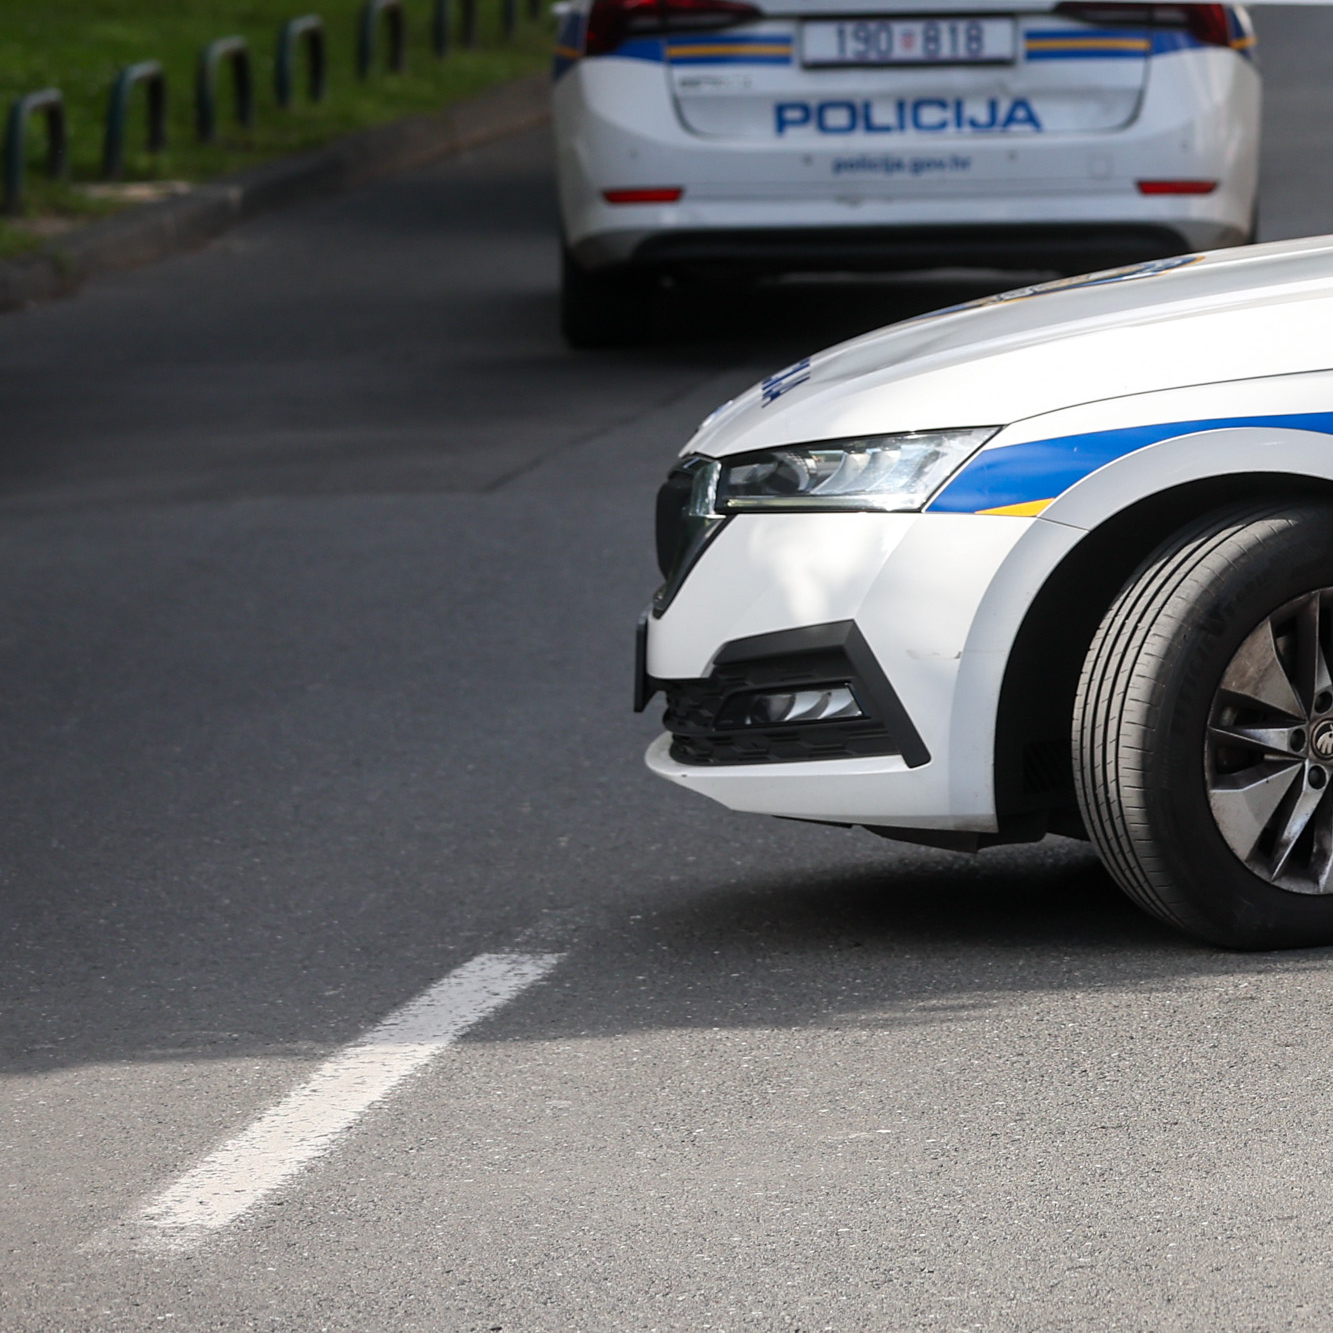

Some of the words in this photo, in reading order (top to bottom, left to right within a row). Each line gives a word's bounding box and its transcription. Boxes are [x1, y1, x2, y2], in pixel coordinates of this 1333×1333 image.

[834, 22, 894, 60] 190
[922, 20, 986, 59] 818
[774, 96, 1043, 138] POLICIJA
